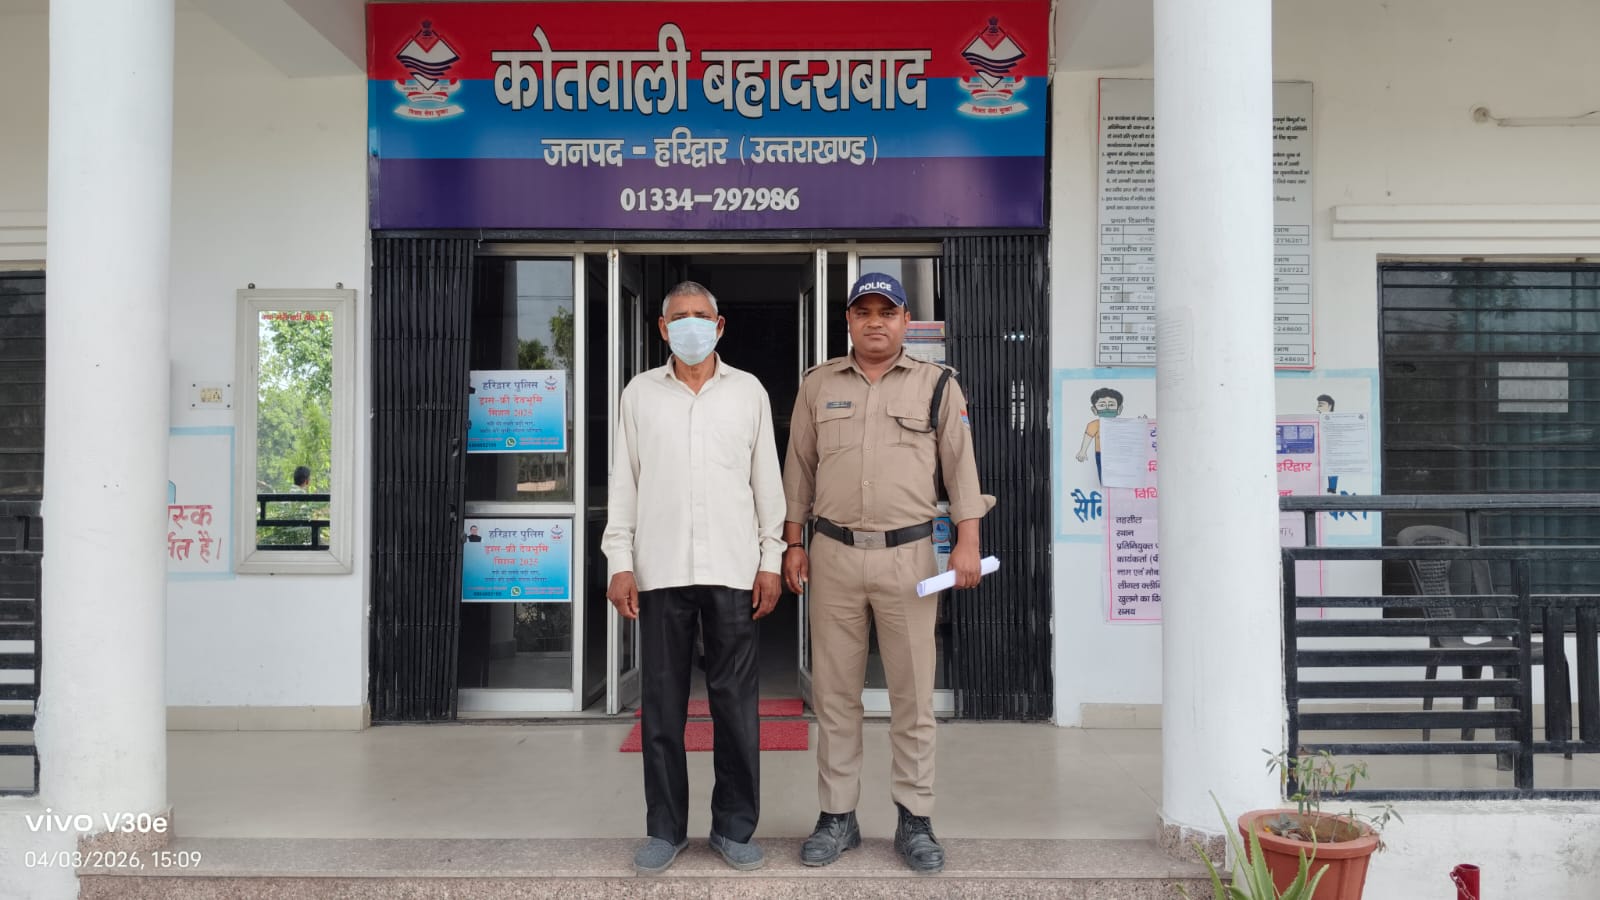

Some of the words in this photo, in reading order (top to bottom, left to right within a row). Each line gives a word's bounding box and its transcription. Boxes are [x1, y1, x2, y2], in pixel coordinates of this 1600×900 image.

[491, 22, 692, 115] कोतवाली
[701, 49, 932, 118] बहादराबाद
[541, 138, 625, 168] जनपद
[653, 126, 729, 168] हरिद्वार
[619, 187, 801, 212] 01334-292986
[858, 281, 893, 293] POLICE
